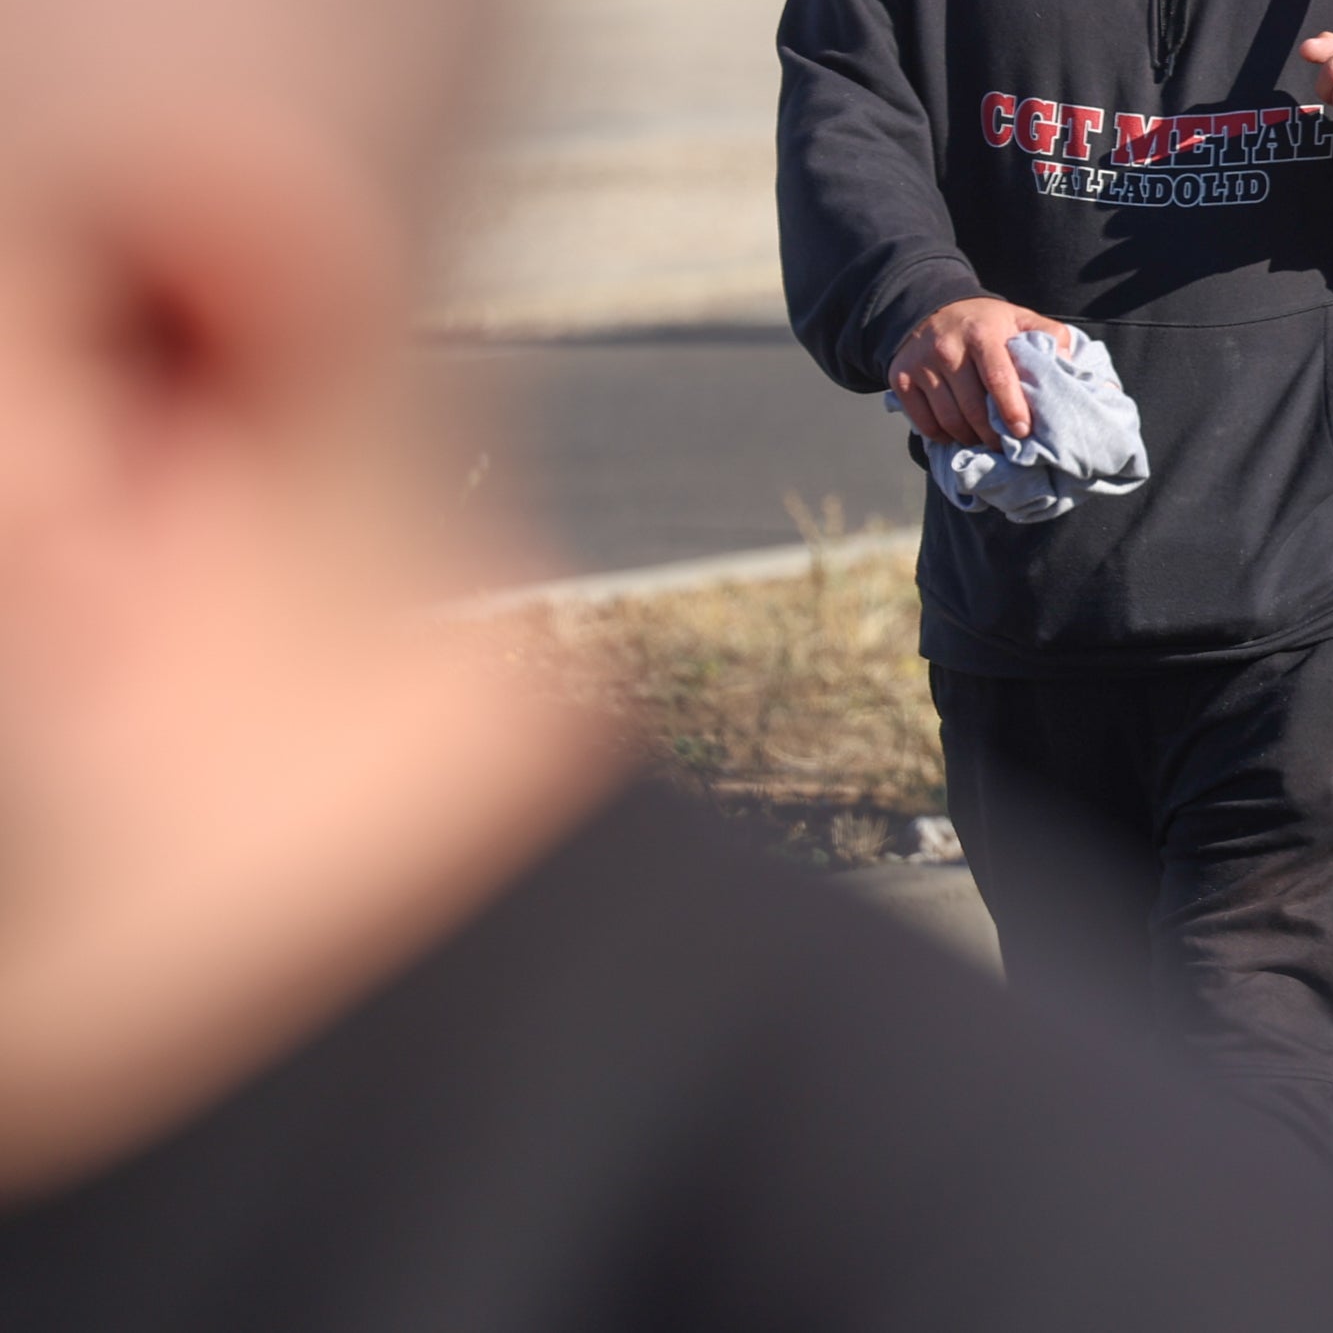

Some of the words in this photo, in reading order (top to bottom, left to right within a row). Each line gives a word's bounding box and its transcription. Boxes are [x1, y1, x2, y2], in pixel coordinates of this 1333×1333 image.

[981, 92, 1103, 160] CGT
[1112, 105, 1333, 166] METAL
[1032, 162, 1269, 207] VALLADOLID
